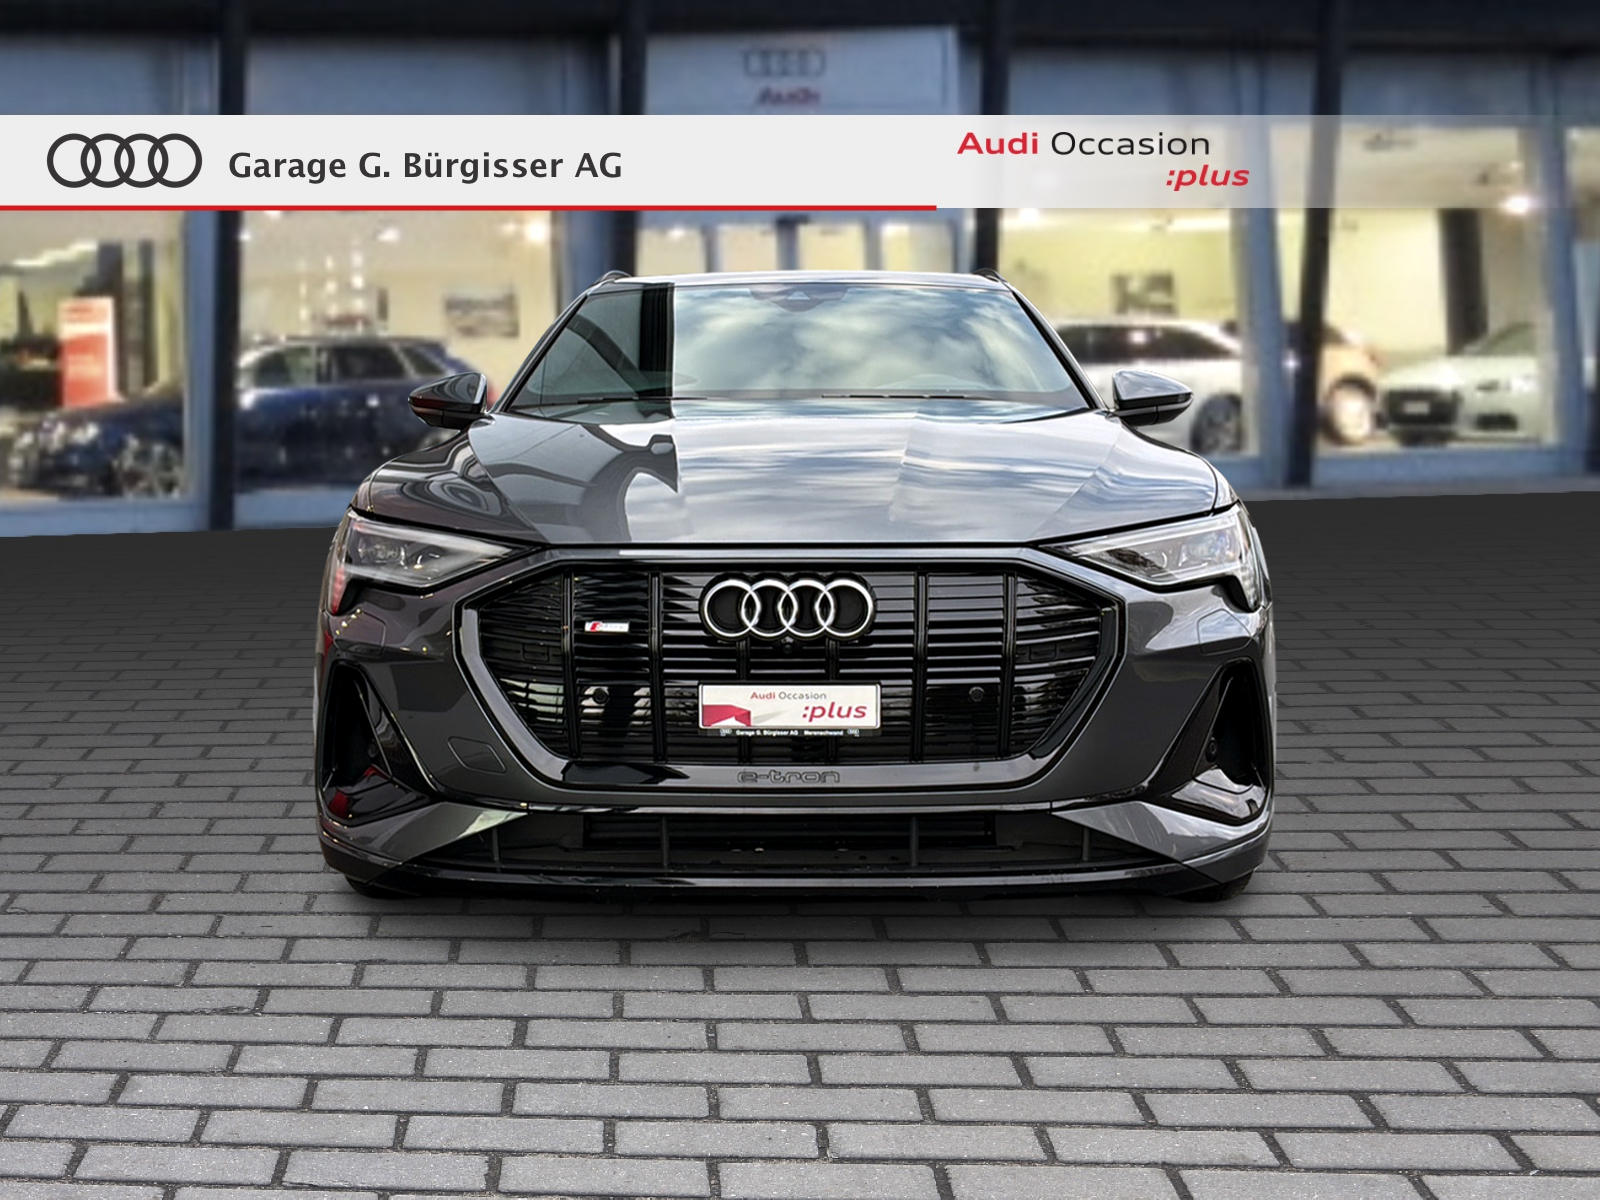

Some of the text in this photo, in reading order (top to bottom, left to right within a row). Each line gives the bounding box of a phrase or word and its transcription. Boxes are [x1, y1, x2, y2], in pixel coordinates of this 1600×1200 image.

[750, 691, 827, 700] Audi Occasion
[802, 701, 867, 722] :plus
[737, 769, 840, 784] e-tron
